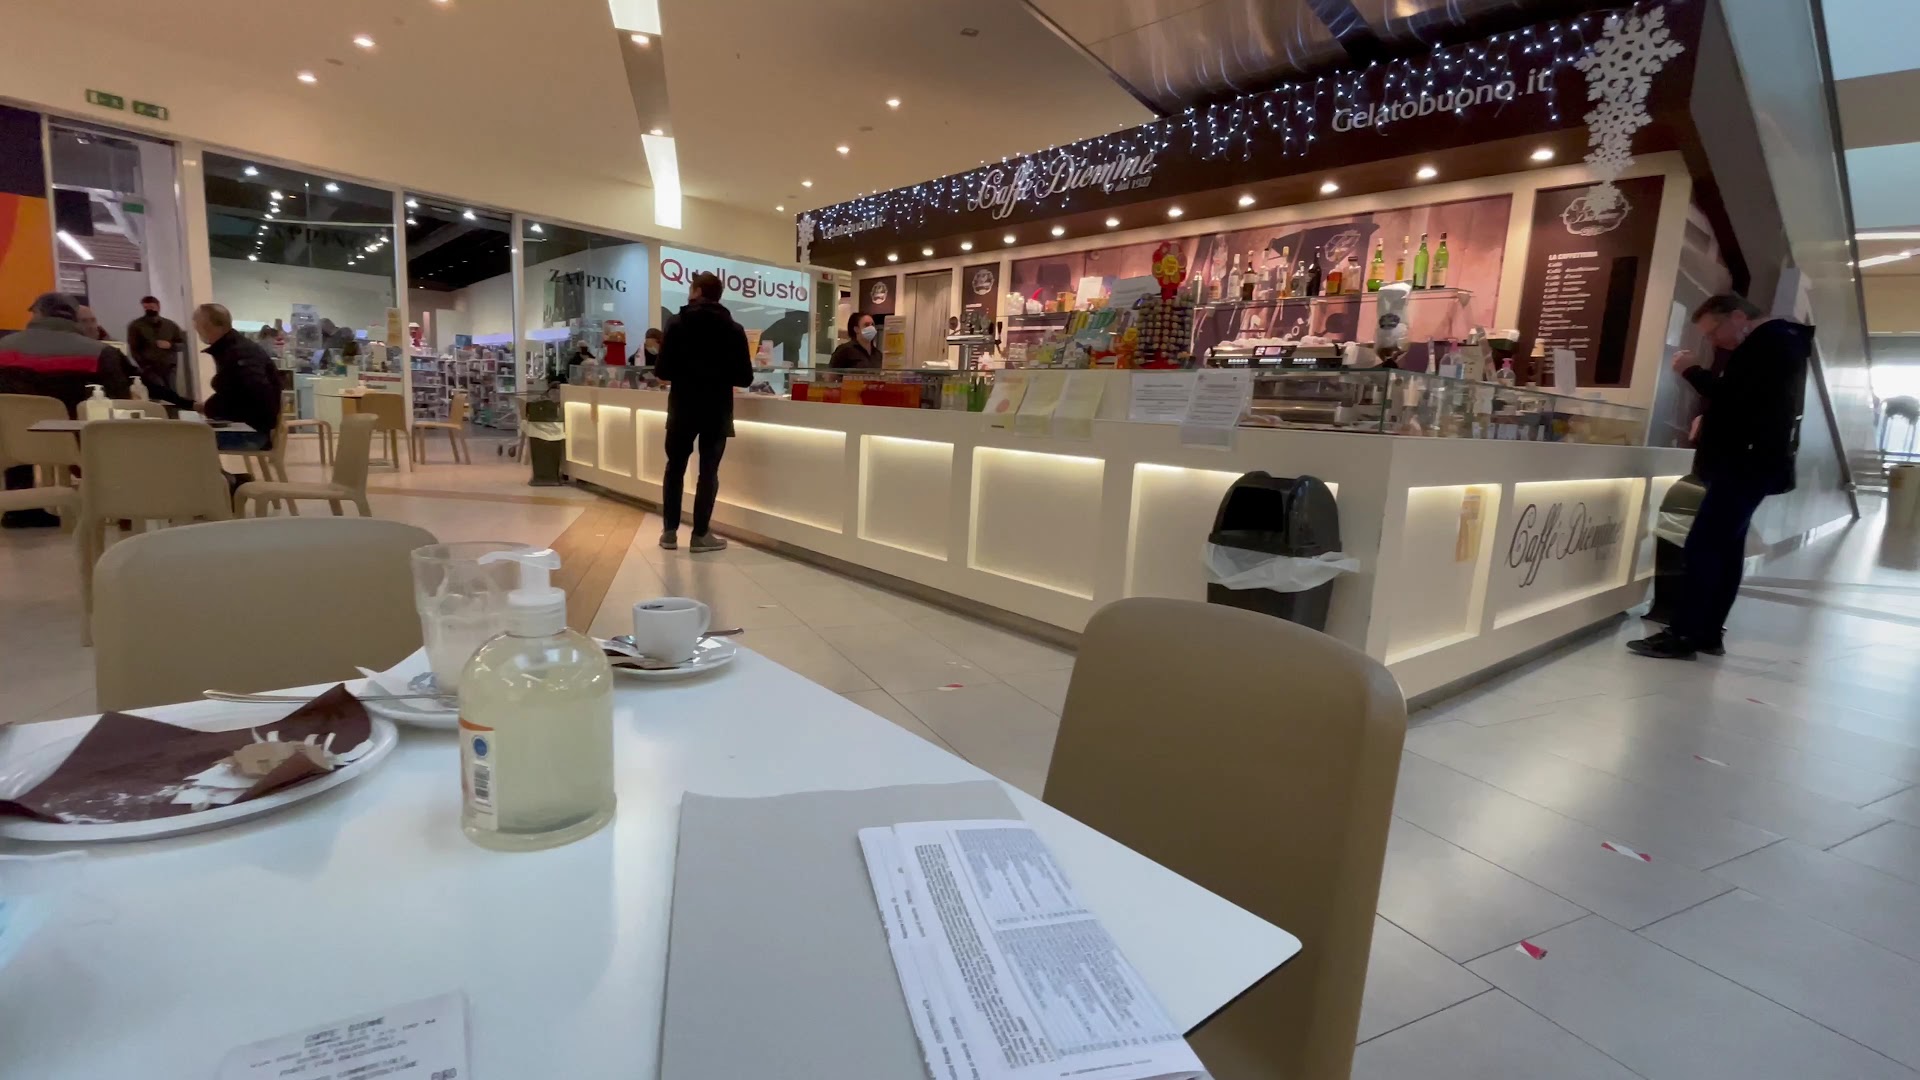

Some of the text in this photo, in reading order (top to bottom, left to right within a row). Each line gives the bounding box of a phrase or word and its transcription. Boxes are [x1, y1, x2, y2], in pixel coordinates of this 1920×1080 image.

[1331, 67, 1551, 133] Gelatobuono.it
[1034, 151, 1157, 198] Diemme
[549, 268, 627, 293] ZAPPING
[660, 258, 808, 302] Qullogiusto
